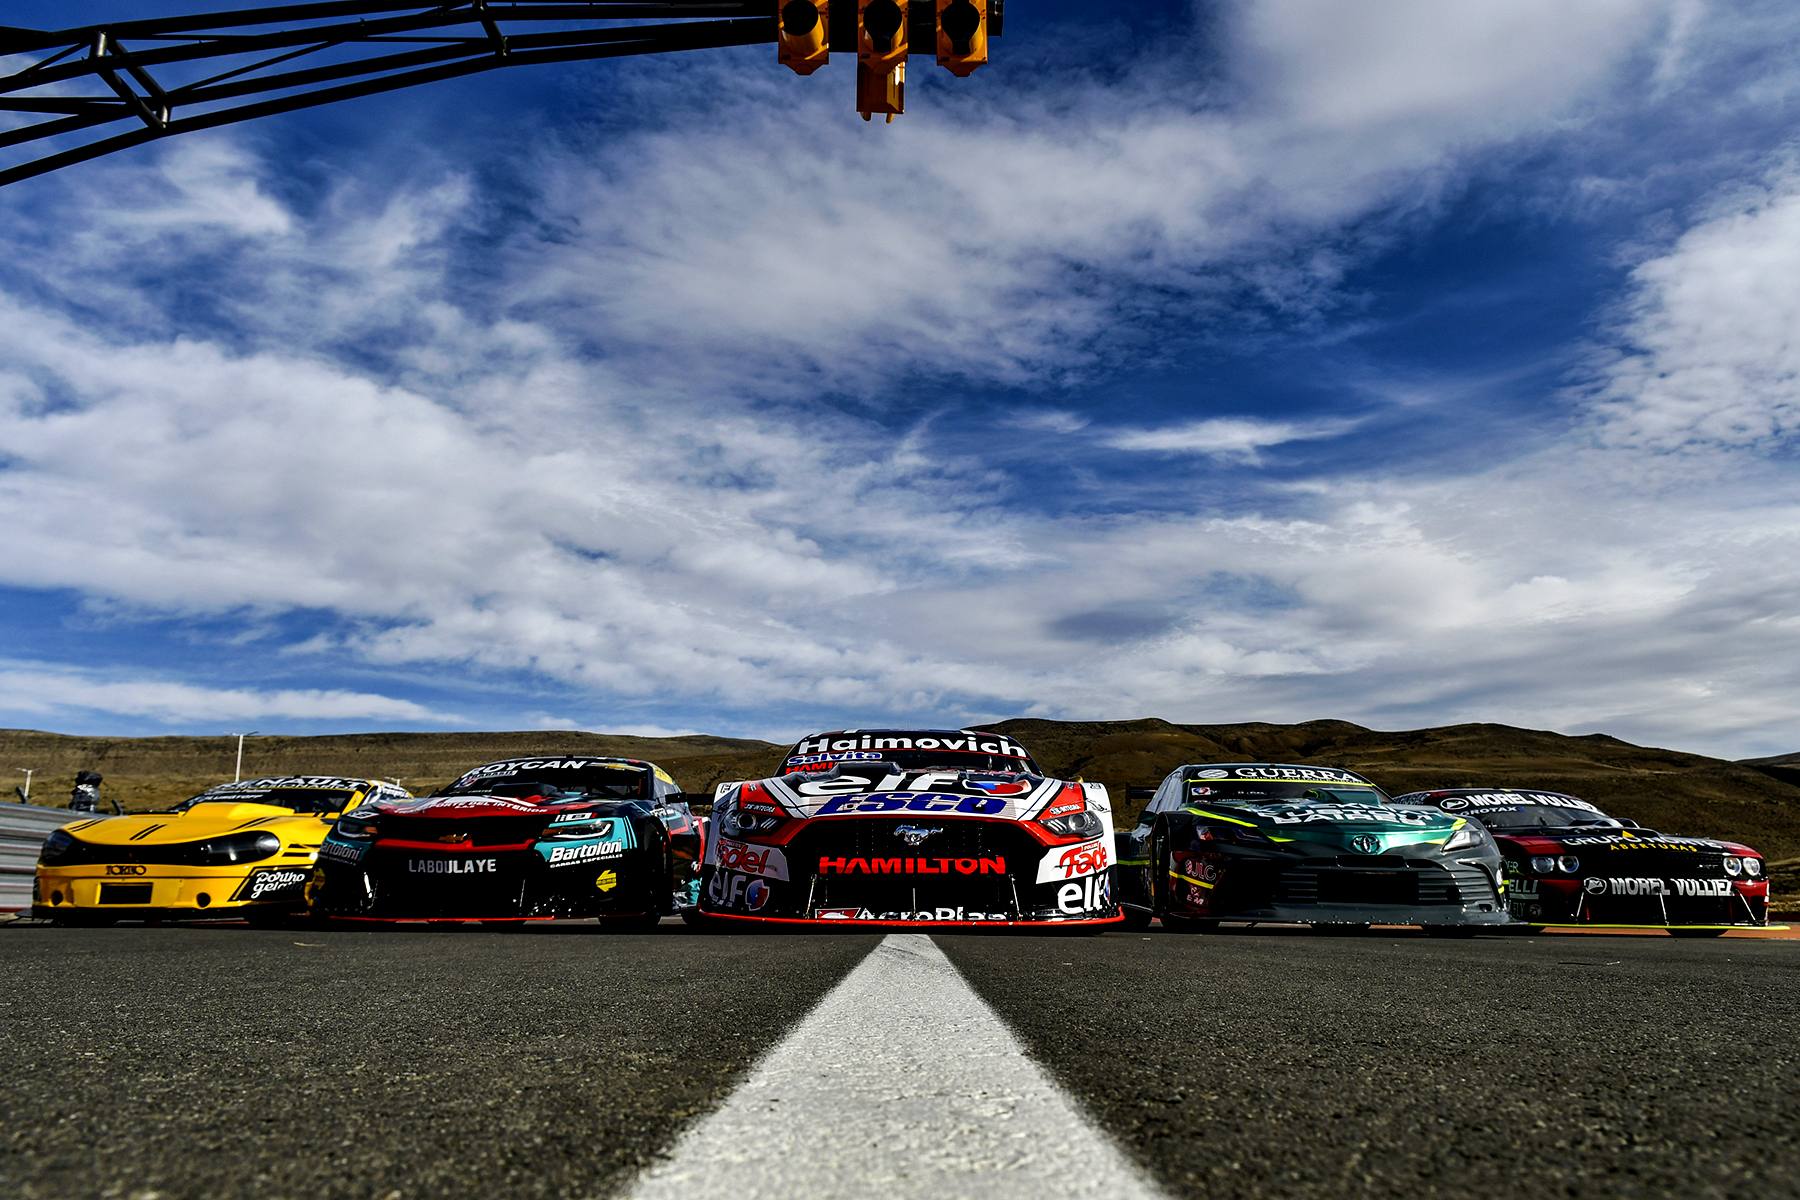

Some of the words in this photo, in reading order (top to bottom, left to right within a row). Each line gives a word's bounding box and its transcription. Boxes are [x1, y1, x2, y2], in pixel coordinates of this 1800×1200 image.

[799, 734, 1025, 759] Haimovich
[786, 751, 883, 766] Salvita
[785, 762, 833, 775] HAMI
[1235, 767, 1363, 783] GUERRA
[799, 772, 958, 796] elf
[814, 792, 1007, 815] ESCO
[1465, 793, 1536, 807] MOREL
[1562, 835, 1643, 846] GRUPO
[1610, 843, 1698, 853] ABERTURAS
[408, 858, 497, 874] LABOULAYE
[818, 856, 1006, 875] HAMILTON
[1609, 878, 1671, 895] MOREL
[1670, 878, 1734, 896] VULLIEZ
